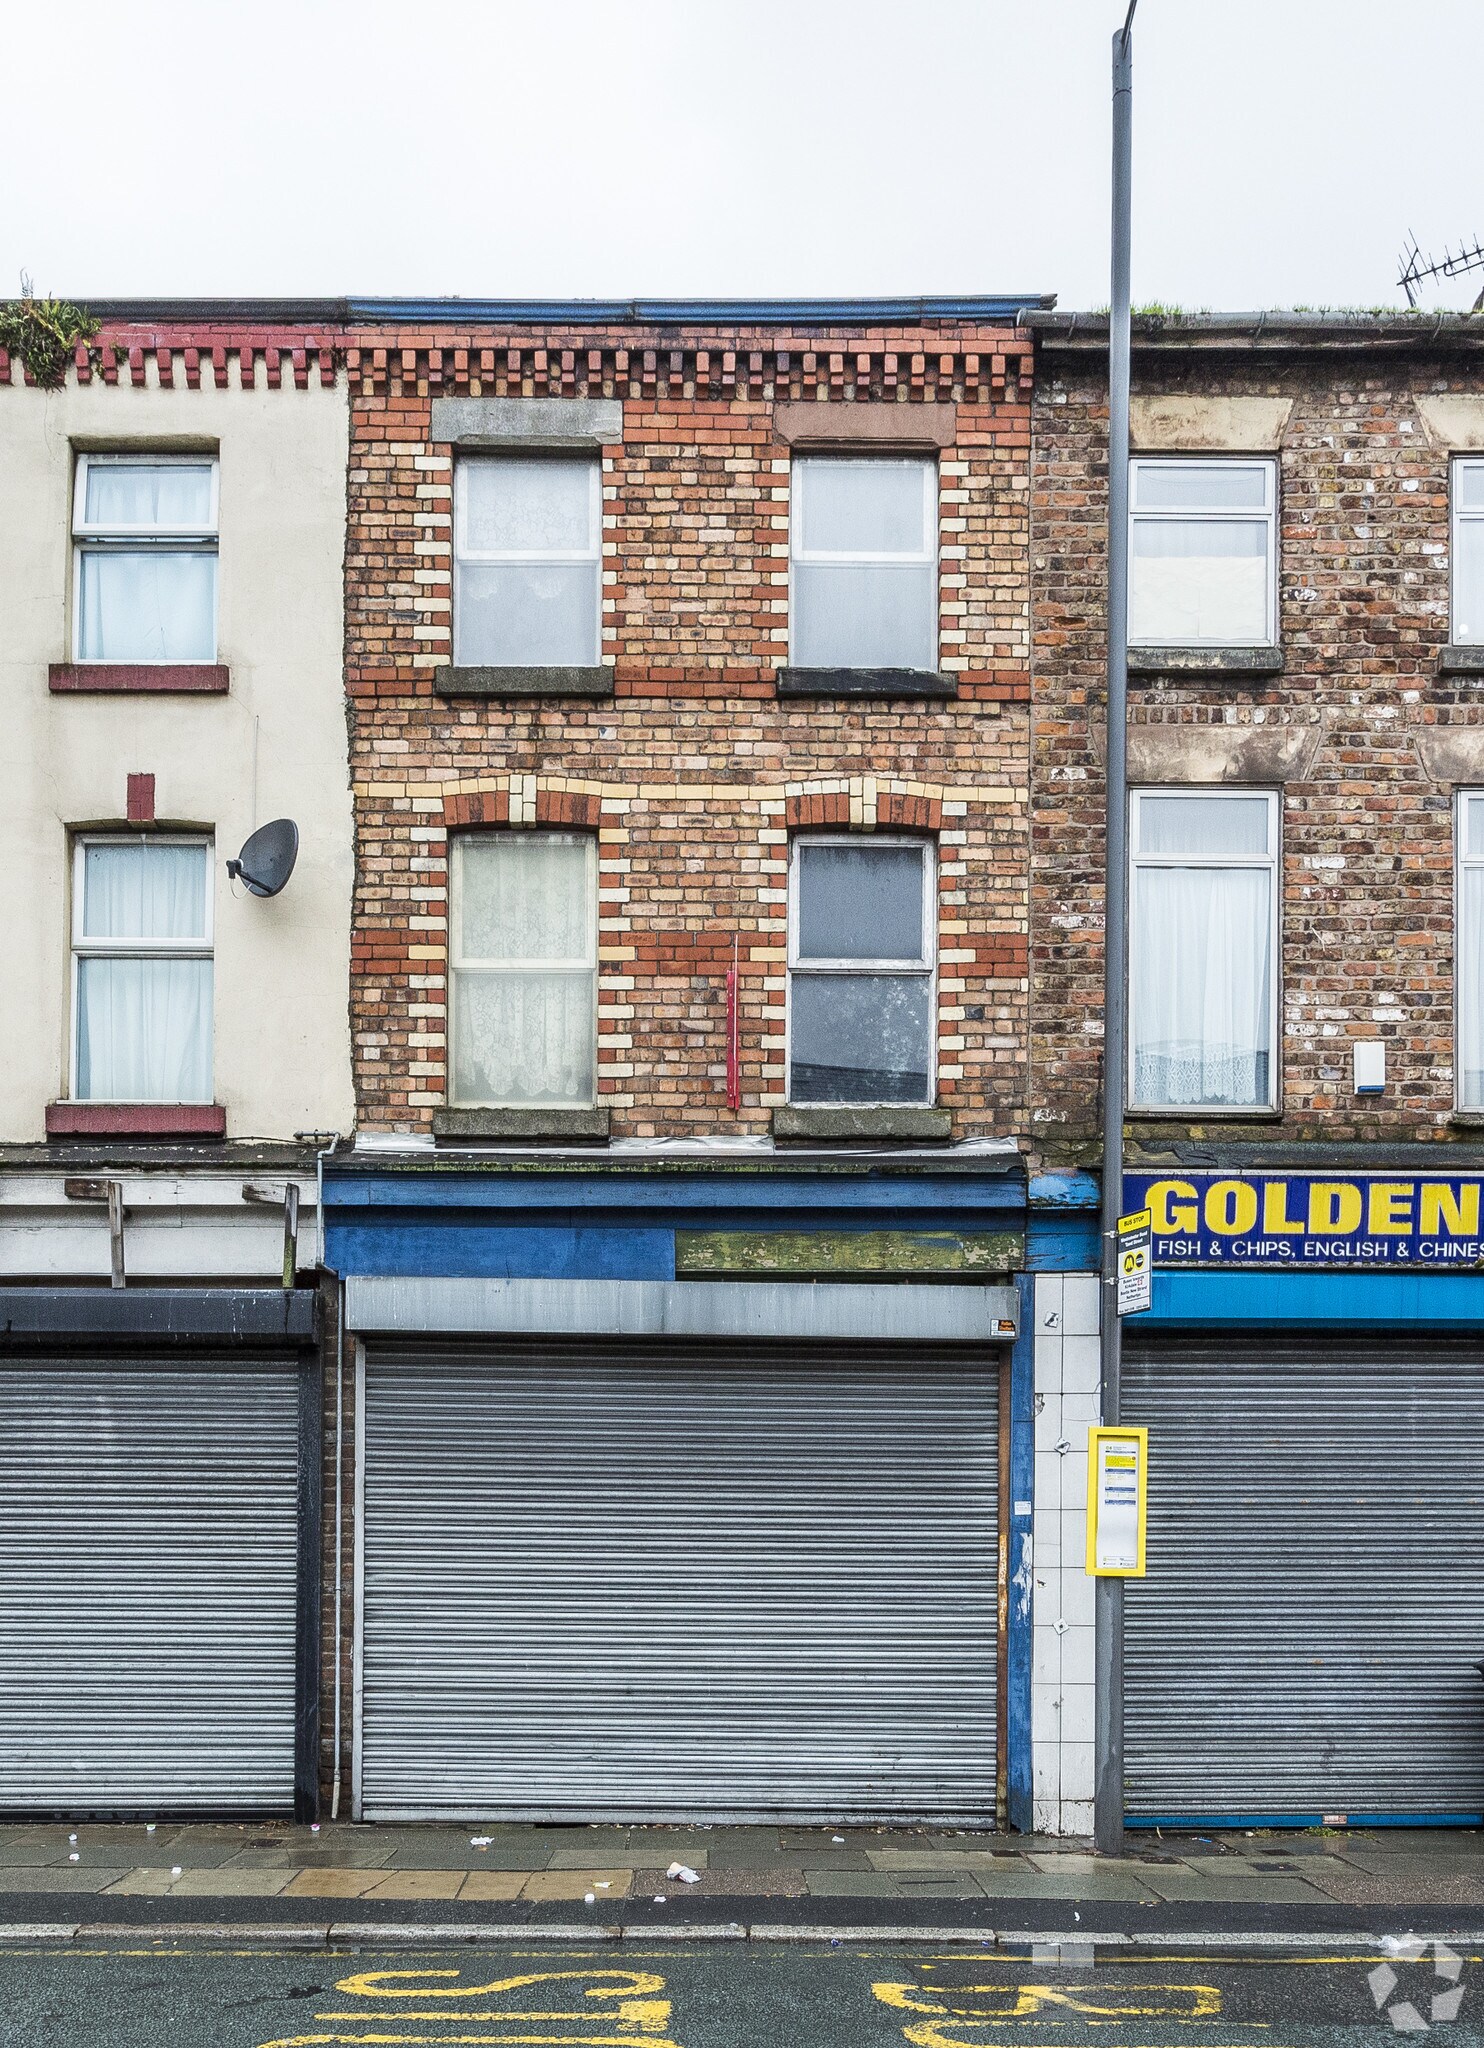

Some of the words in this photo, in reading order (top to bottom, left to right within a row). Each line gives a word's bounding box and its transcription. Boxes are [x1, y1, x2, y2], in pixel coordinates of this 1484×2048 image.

[1144, 1180, 1481, 1236] GOLDEN
[1133, 1215, 1144, 1225] STOP
[1158, 1240, 1201, 1256] FISH
[1209, 1240, 1223, 1256] &
[1231, 1240, 1296, 1258] CHIPS,
[1304, 1241, 1389, 1257] ENGLISH
[1396, 1241, 1410, 1257] &
